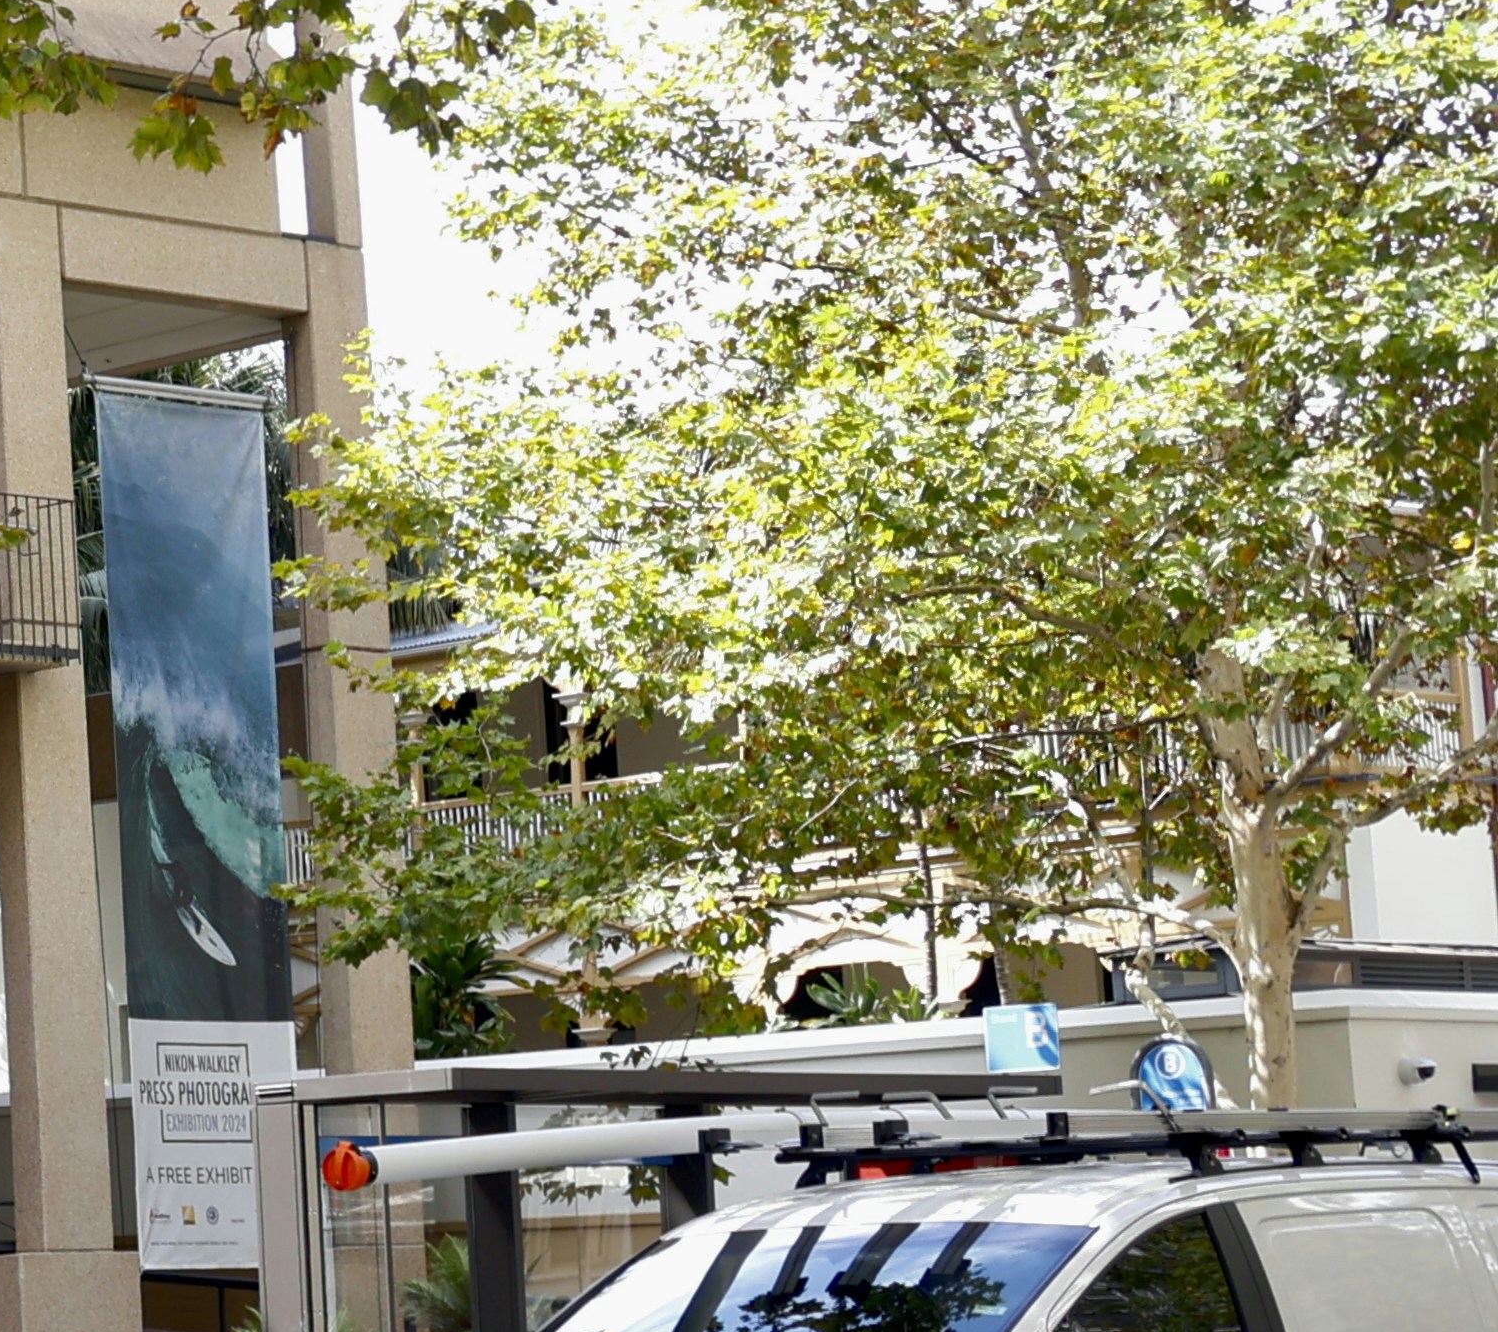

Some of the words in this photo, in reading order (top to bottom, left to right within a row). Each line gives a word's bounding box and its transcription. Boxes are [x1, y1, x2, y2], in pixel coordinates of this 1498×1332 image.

[1024, 1011, 1049, 1048] B
[165, 1054, 240, 1073] NIKON-WALKLEY
[1164, 1052, 1177, 1073] B
[139, 1080, 174, 1105] PRESS
[178, 1081, 251, 1106] PHOTOGRA
[166, 1114, 219, 1132] EXHIBITION
[222, 1115, 246, 1132] 2024
[146, 1167, 155, 1184] A
[158, 1167, 192, 1184] FREE
